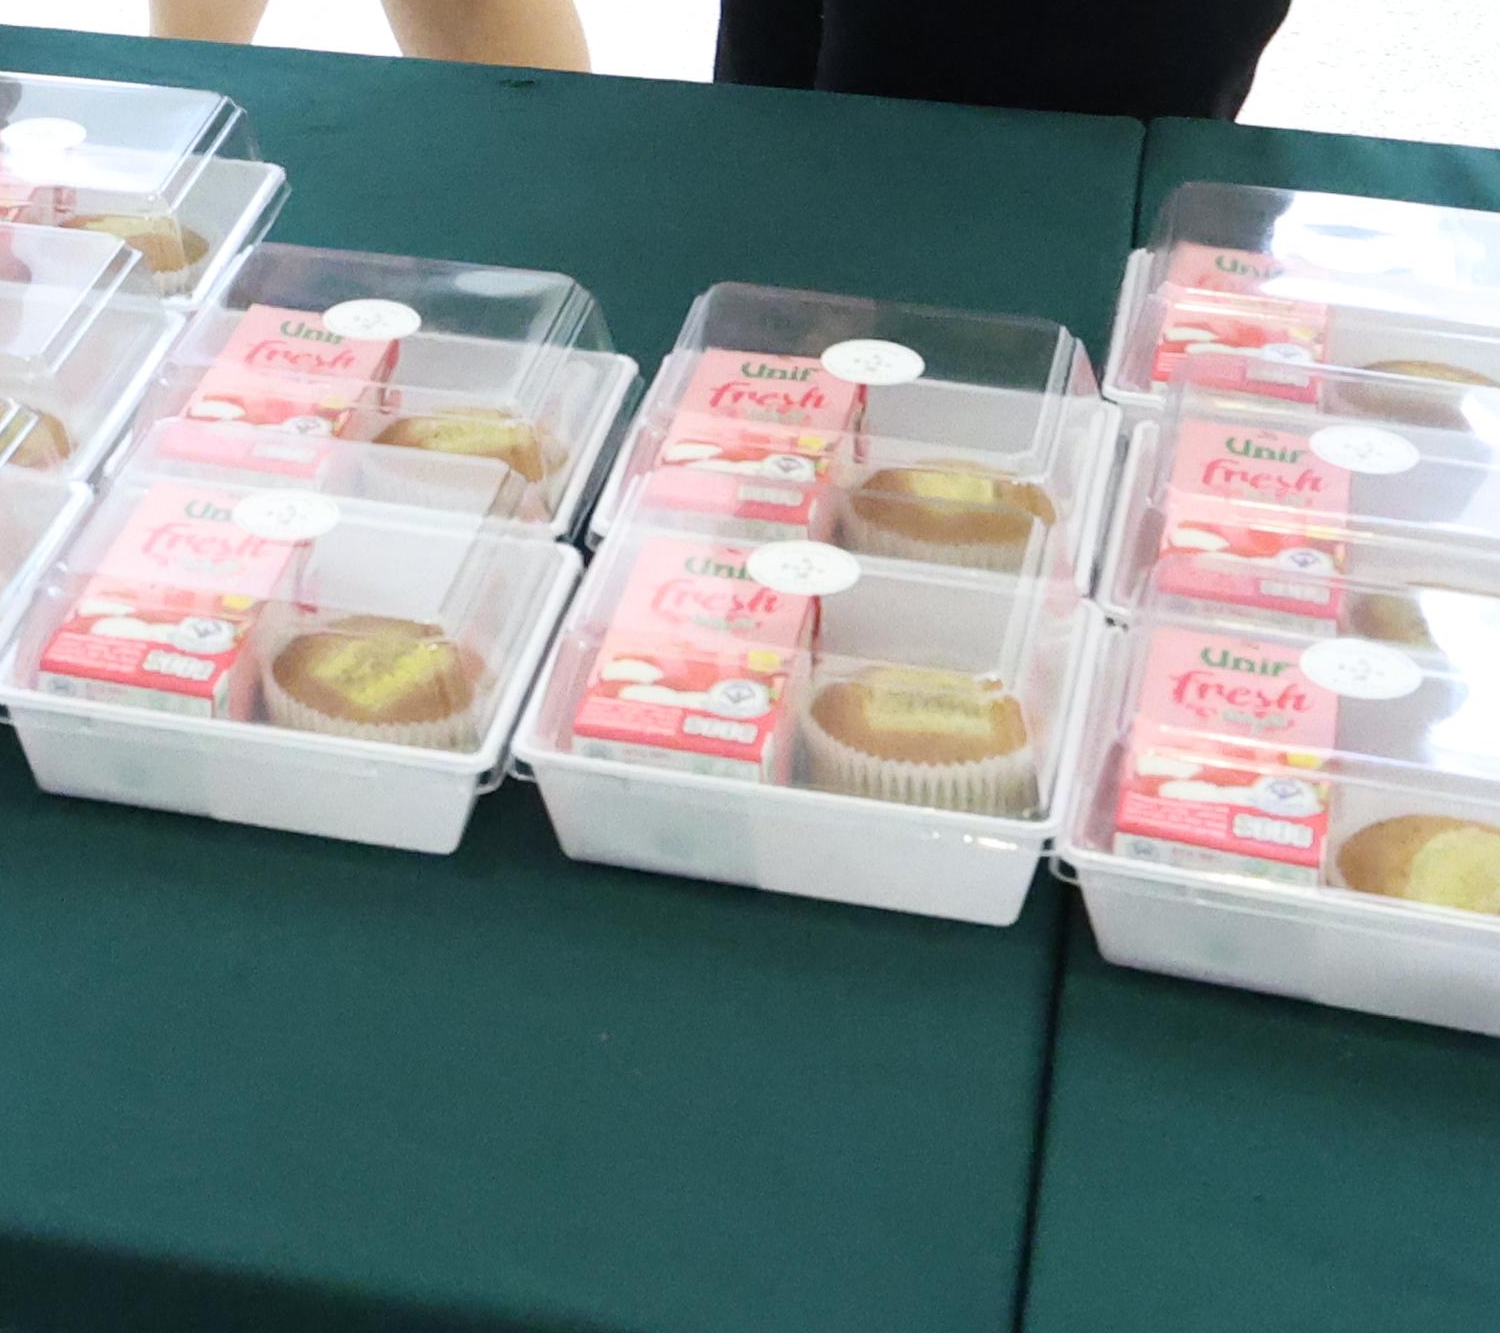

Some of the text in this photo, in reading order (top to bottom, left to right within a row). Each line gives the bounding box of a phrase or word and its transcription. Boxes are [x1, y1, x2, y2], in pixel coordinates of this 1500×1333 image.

[244, 340, 356, 370] fresh
[741, 361, 820, 382] Unif
[710, 381, 826, 411] fresh
[1225, 436, 1308, 464] Unif
[1201, 458, 1326, 496] fresh
[184, 499, 233, 524] Un
[141, 522, 268, 560] fresh
[684, 556, 755, 582] Uni
[650, 578, 779, 617] fresh
[1200, 646, 1298, 677] Unif
[1170, 670, 1316, 716] fresh
